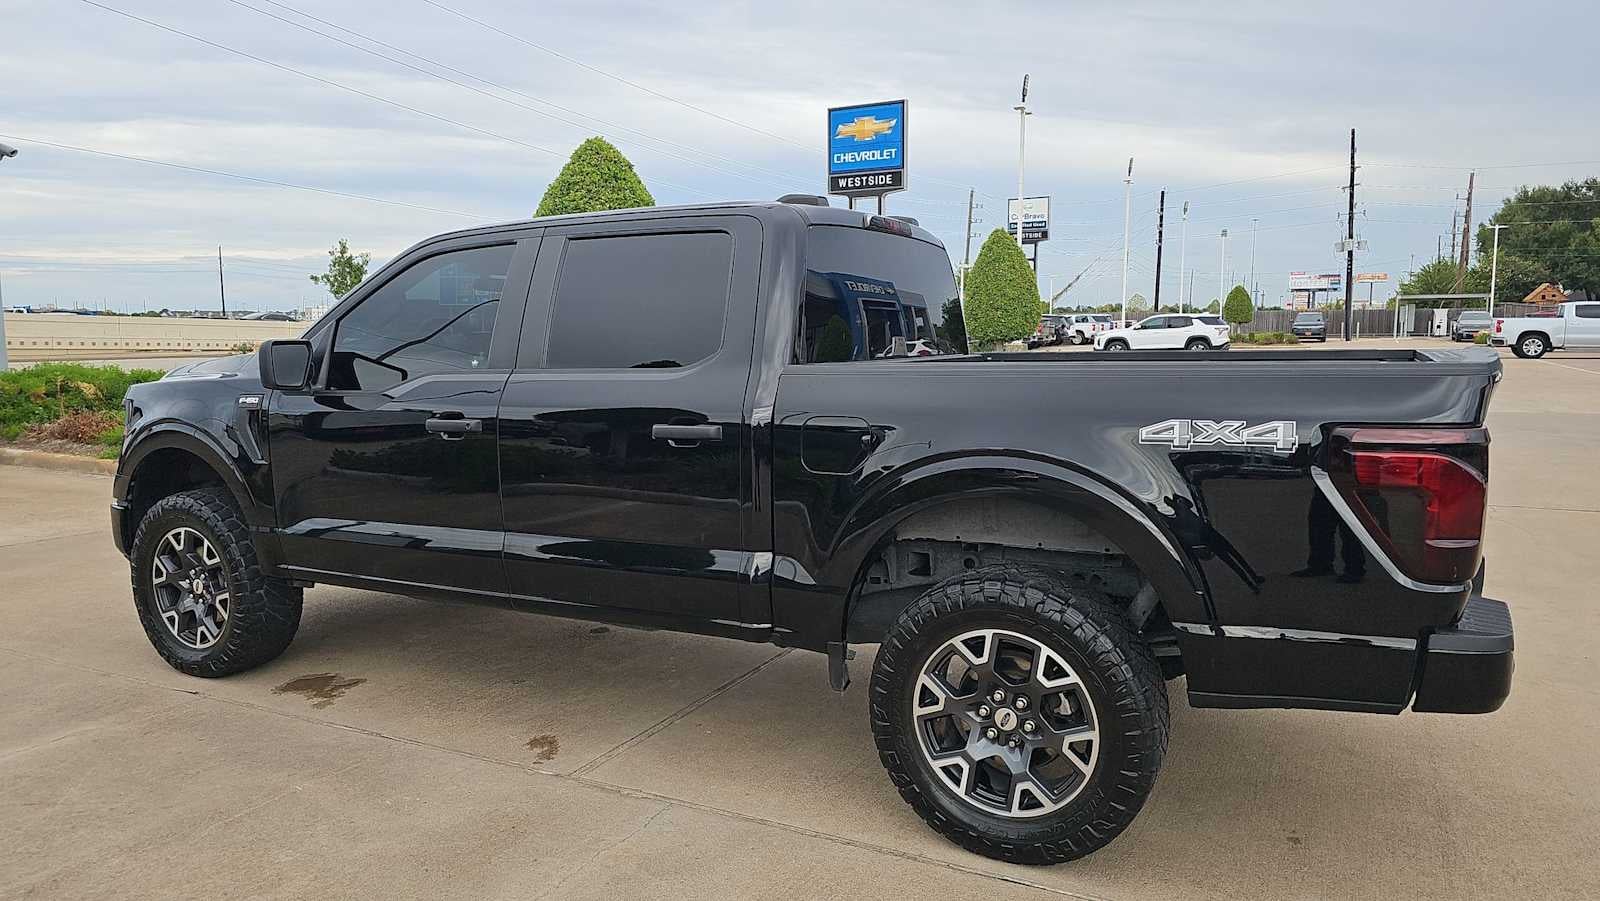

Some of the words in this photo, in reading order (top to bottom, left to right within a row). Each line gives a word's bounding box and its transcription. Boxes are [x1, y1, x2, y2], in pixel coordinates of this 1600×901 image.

[834, 148, 897, 164] CHEVROLET
[838, 174, 893, 188] WESTSIDE
[1011, 212, 1045, 221] CBravo
